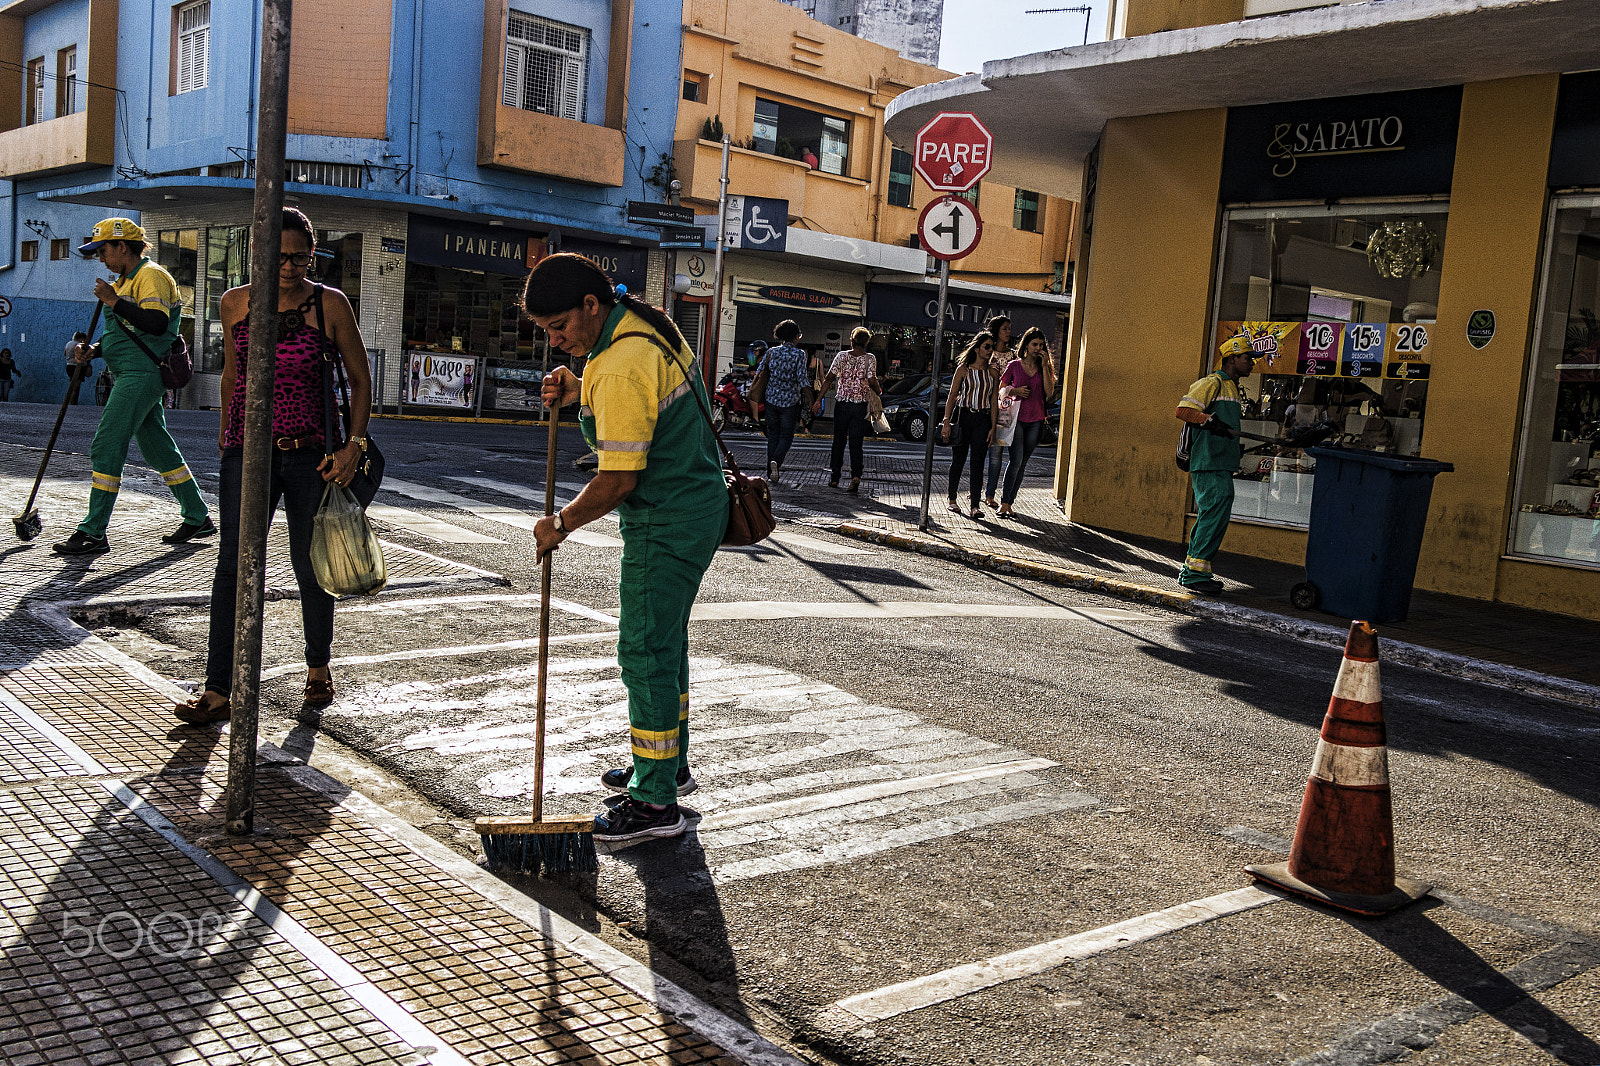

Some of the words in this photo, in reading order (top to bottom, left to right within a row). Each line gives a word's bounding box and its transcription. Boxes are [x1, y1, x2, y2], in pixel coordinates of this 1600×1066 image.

[1293, 115, 1403, 152] SAPATO
[922, 141, 986, 164] PARE
[445, 233, 522, 261] IPANEMA
[769, 288, 806, 301] PASTELARIA
[1307, 325, 1334, 350] 10%
[1351, 325, 1380, 351] 15%
[1396, 326, 1428, 352] 20%
[423, 355, 463, 382] Oxage
[1306, 358, 1317, 375] 2
[1350, 360, 1361, 377] 3
[1396, 361, 1408, 378] 4
